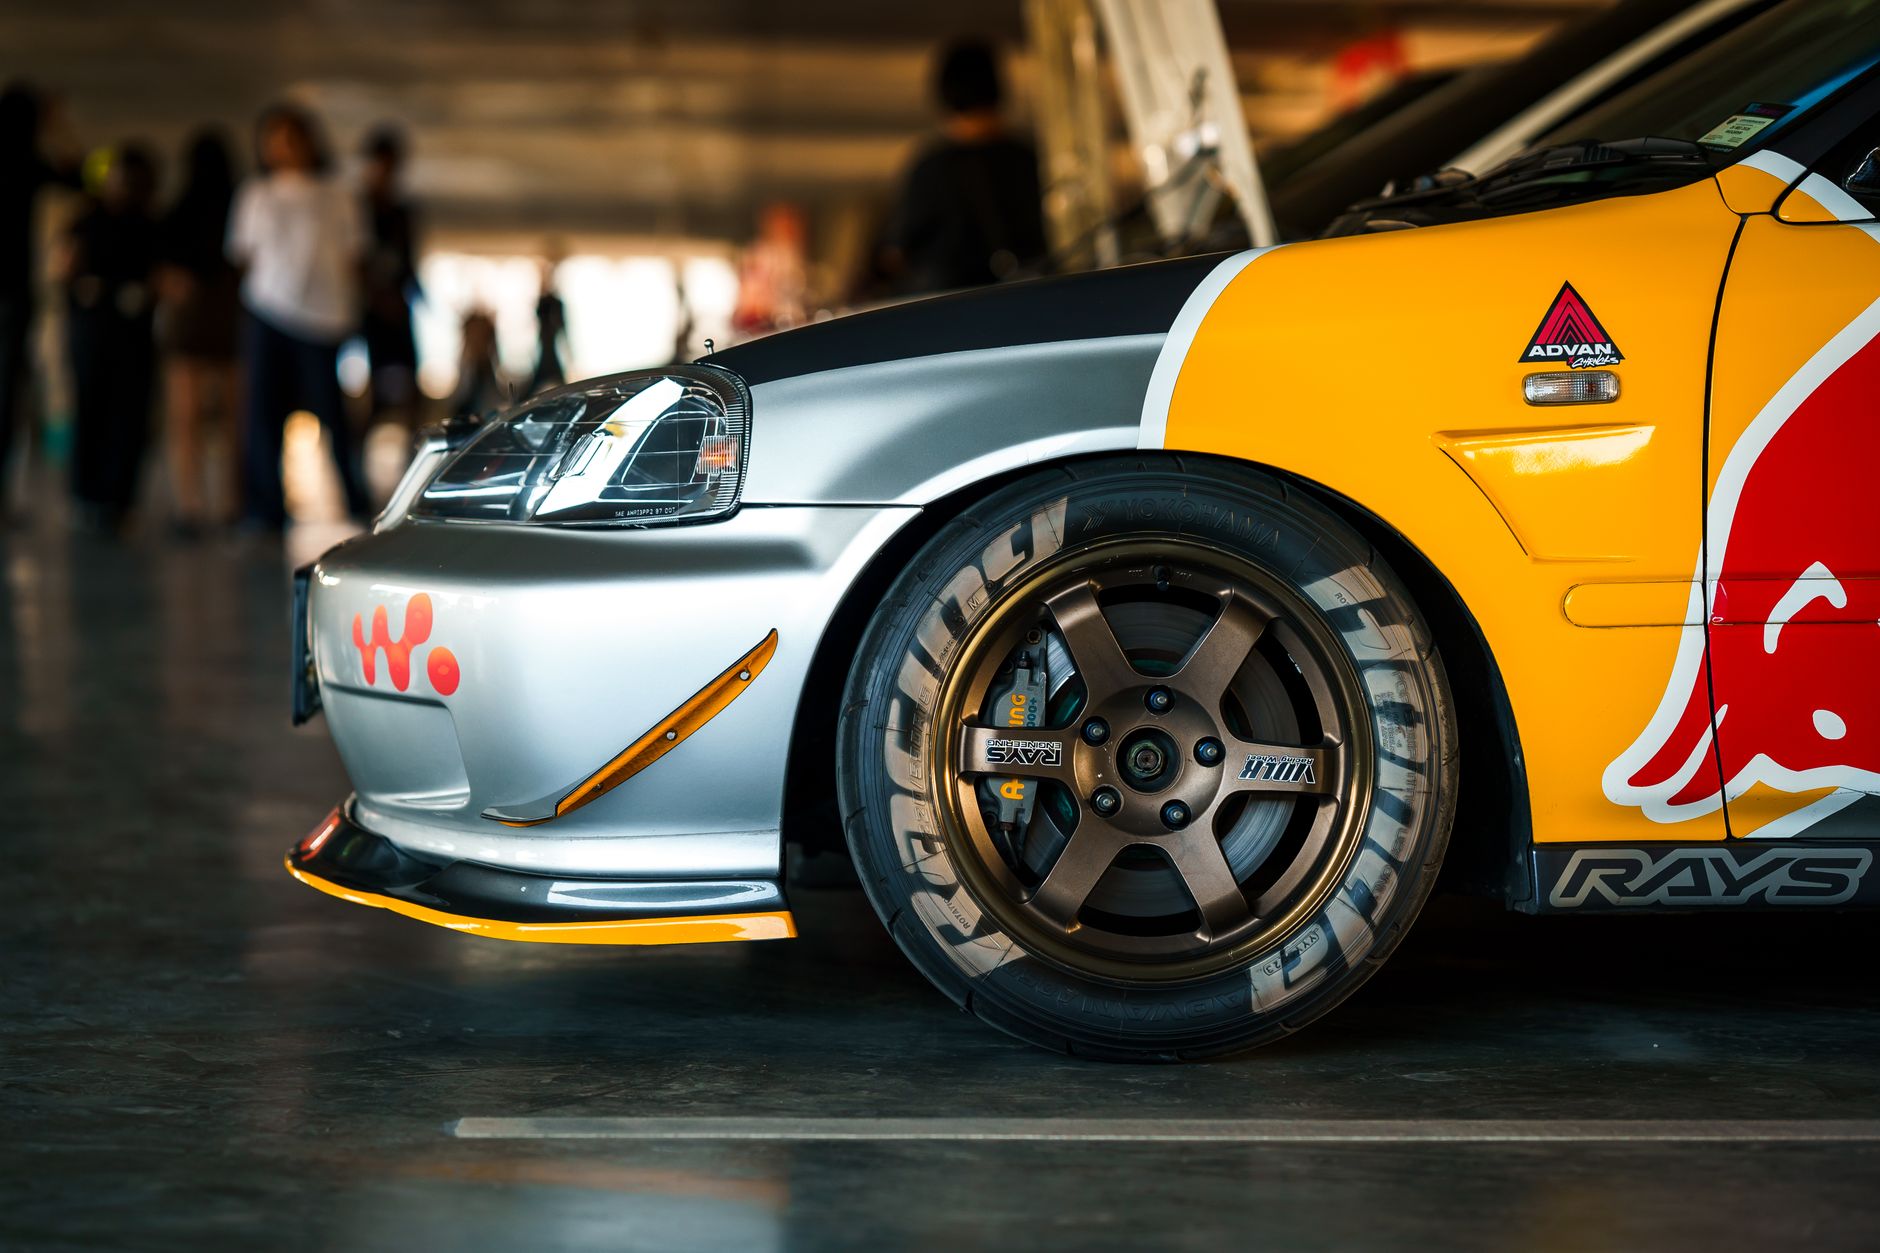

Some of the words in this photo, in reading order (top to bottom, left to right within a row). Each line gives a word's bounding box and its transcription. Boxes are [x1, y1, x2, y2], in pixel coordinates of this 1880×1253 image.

[1528, 343, 1612, 357] ADVAN
[1120, 498, 1280, 553] YOKOHAMA
[967, 596, 980, 611] M
[986, 739, 1062, 749] ENGINEERING
[986, 747, 1062, 766] RAYS
[1246, 755, 1277, 763] Wheel
[1279, 755, 1314, 765] Racing
[1238, 760, 1316, 784] VOLK
[1549, 848, 1873, 907] RAYS
[1079, 984, 1254, 1022] ADVAN
